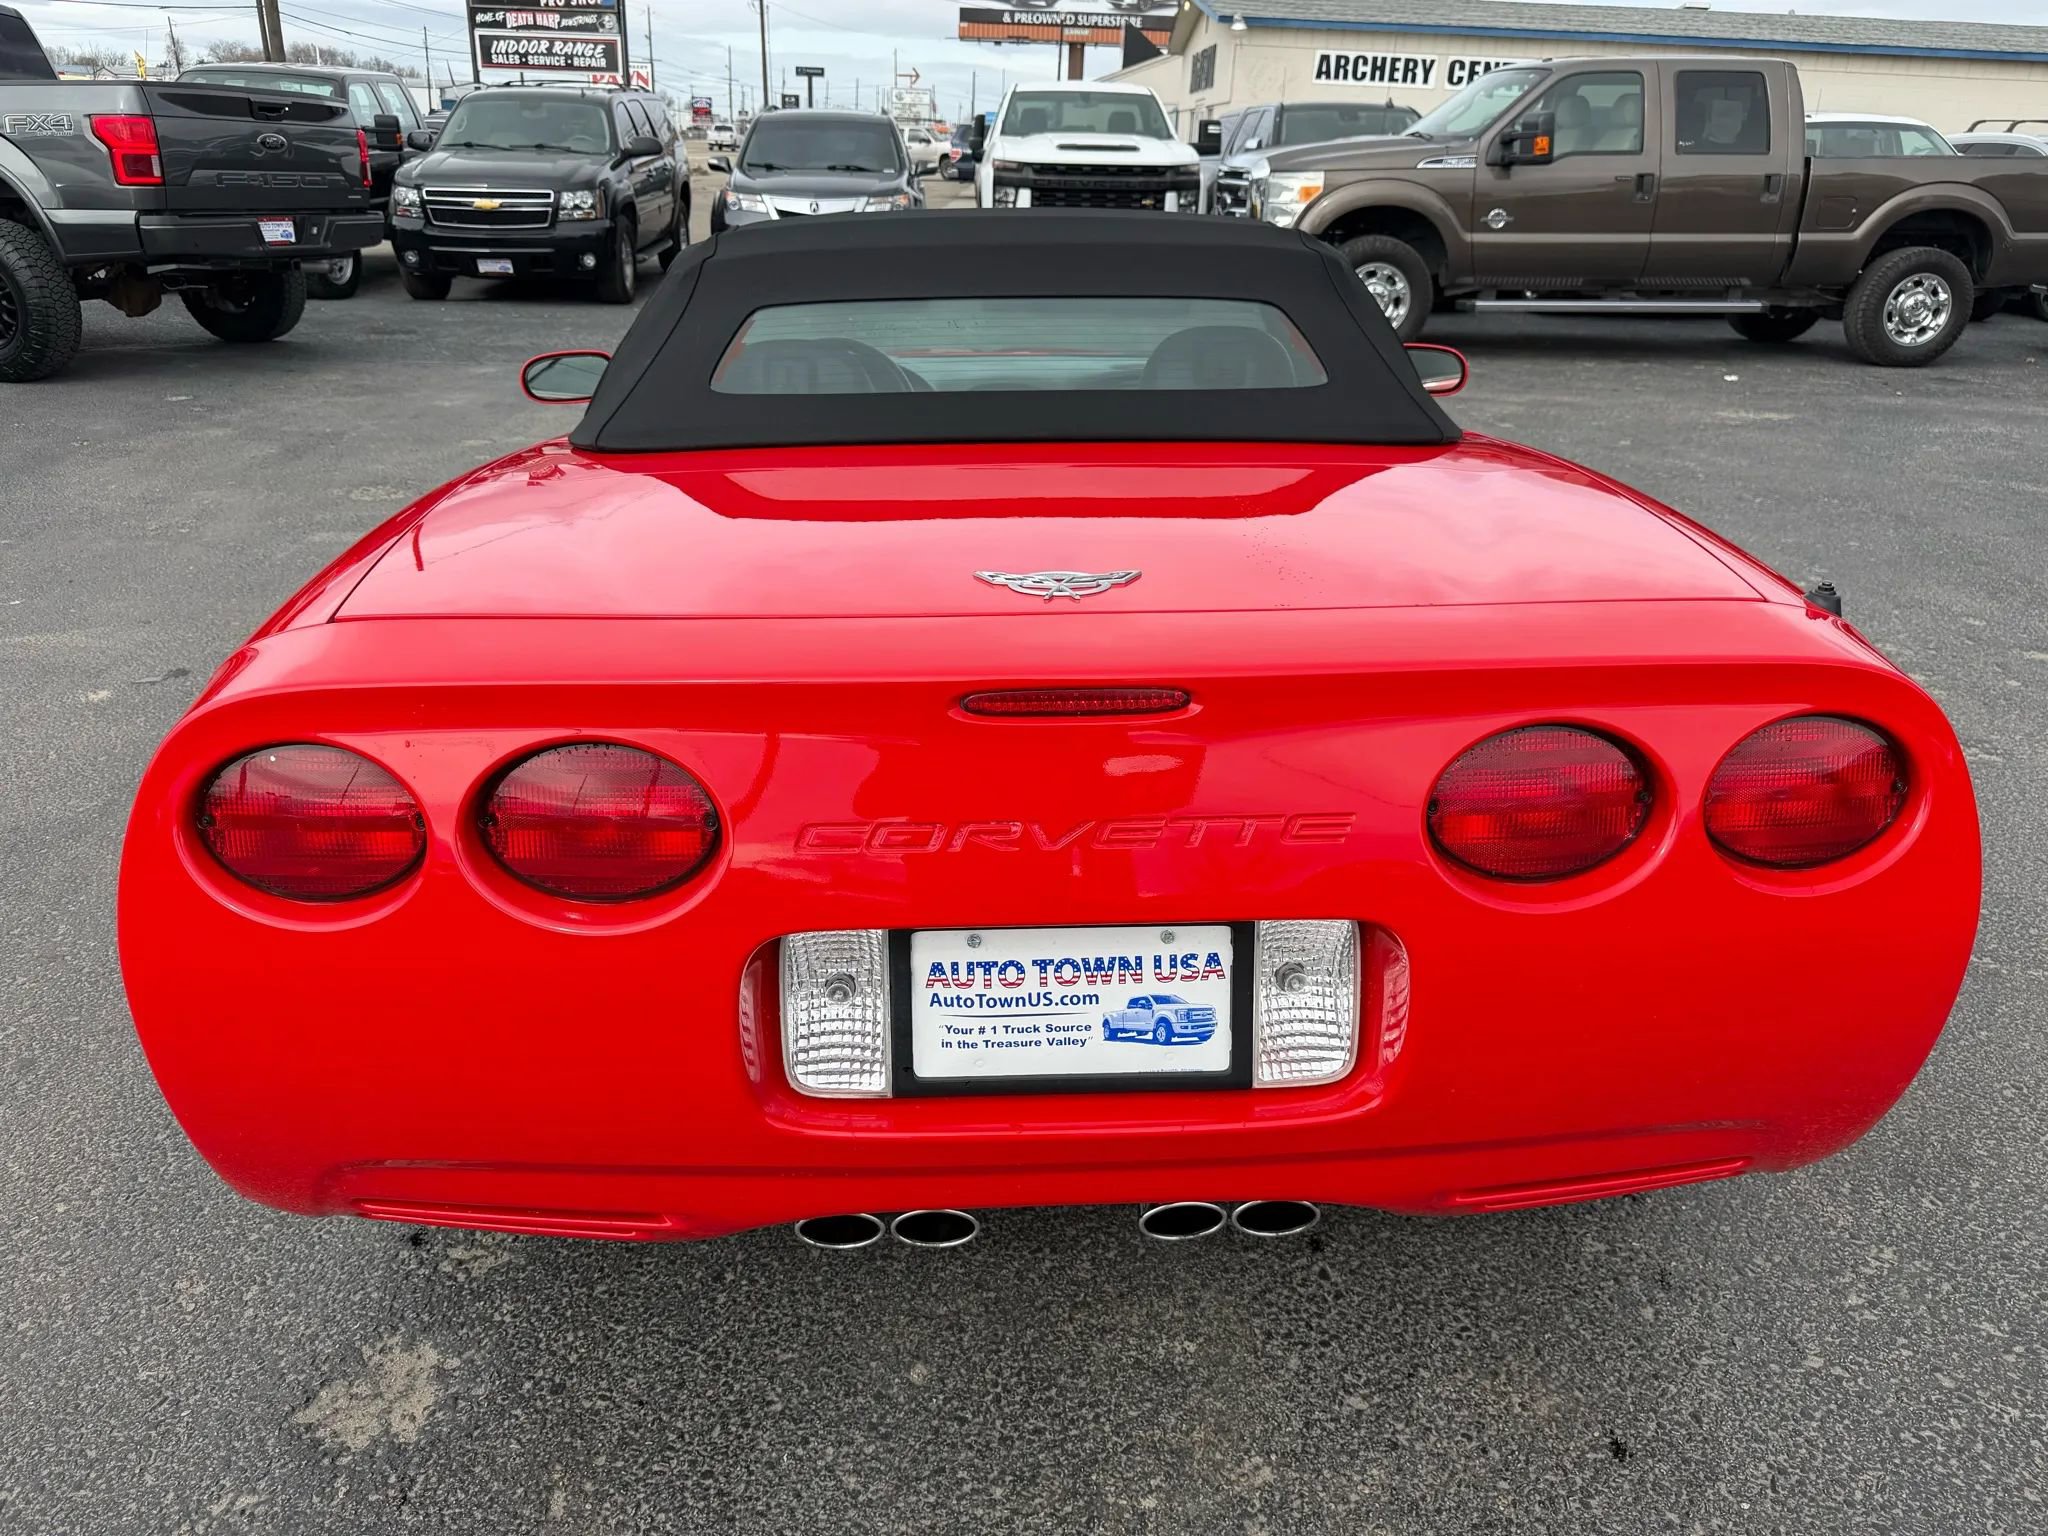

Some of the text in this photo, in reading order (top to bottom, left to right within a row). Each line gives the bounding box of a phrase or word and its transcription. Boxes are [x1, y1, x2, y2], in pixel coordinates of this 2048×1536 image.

[475, 12, 495, 24] HOME
[495, 11, 505, 22] OF
[506, 11, 534, 28] DEATH
[535, 12, 560, 30] HARP
[1002, 11, 1011, 23] &
[490, 39, 606, 57] INDOOR RANGE
[491, 54, 607, 68] SALES SERVICE REPAIR
[1315, 54, 1518, 86] ARCHERY CE
[591, 71, 650, 88] PAN
[3, 113, 74, 136] FX4
[215, 172, 329, 189] F-150
[793, 811, 1357, 856] CORVETTE
[925, 952, 1226, 989] AUTO TOWN USA
[929, 991, 1100, 1009] AutoTownUS.com
[990, 1025, 997, 1035] 1
[1002, 1024, 1041, 1034] Truck
[1045, 1023, 1092, 1033] Source
[941, 1038, 953, 1049] in
[957, 1038, 978, 1049] the
[982, 1038, 1042, 1049] Treasure
